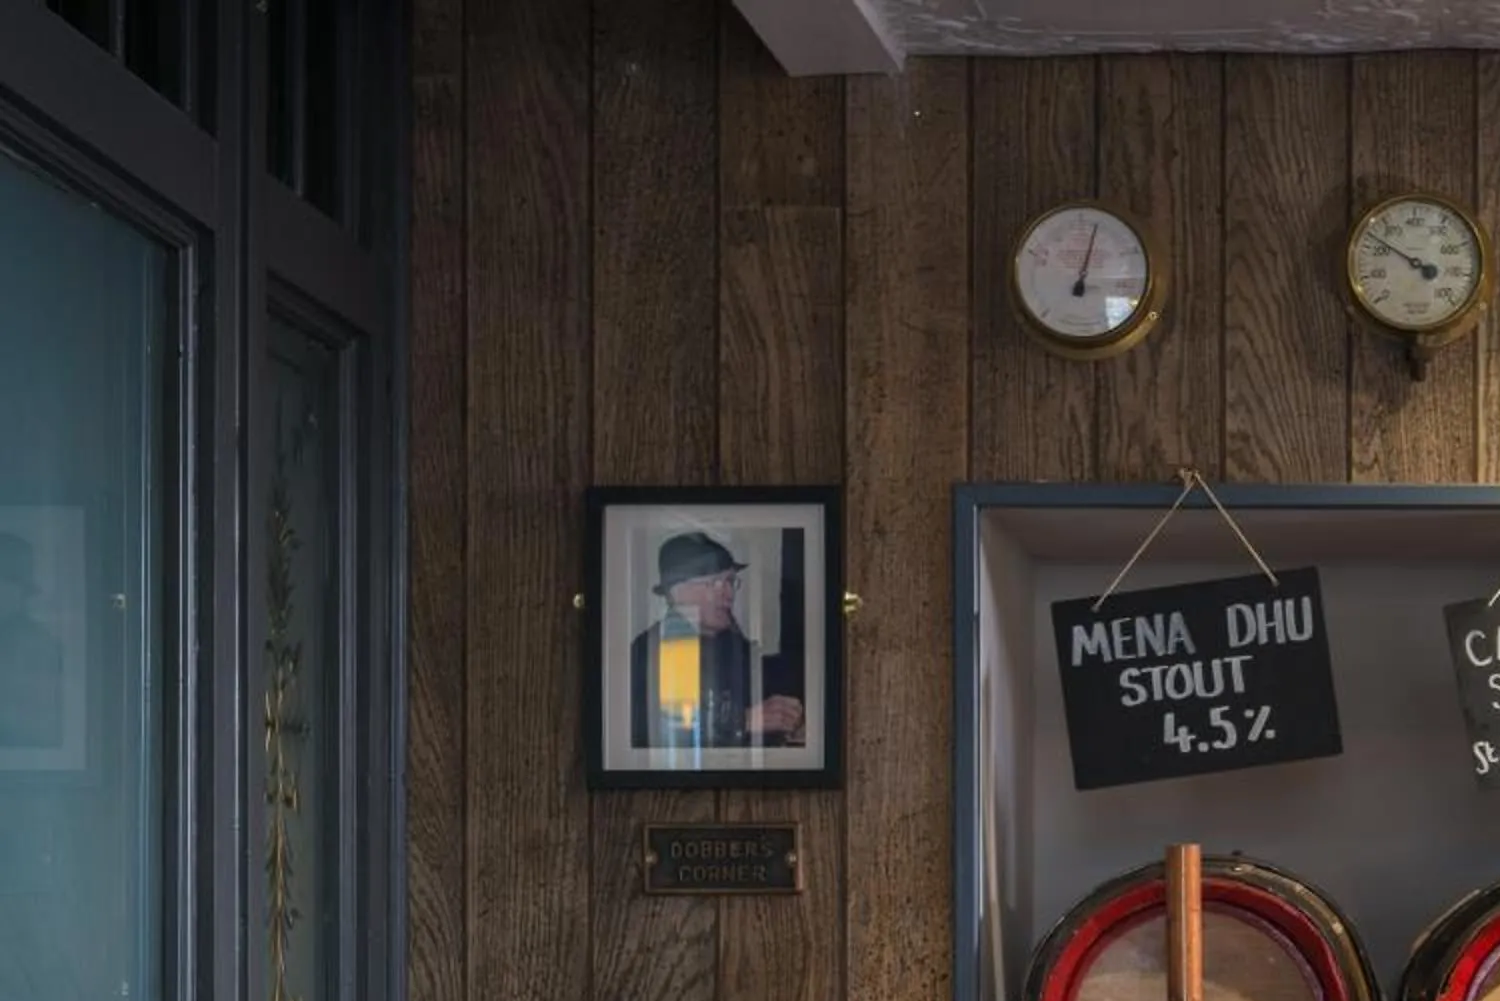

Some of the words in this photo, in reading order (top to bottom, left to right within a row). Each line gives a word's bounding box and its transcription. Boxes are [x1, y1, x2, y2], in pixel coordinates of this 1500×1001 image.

[1071, 611, 1196, 667] MENA
[1226, 596, 1314, 648] DHU
[1119, 654, 1254, 707] STOUT
[679, 864, 767, 882] CORNER
